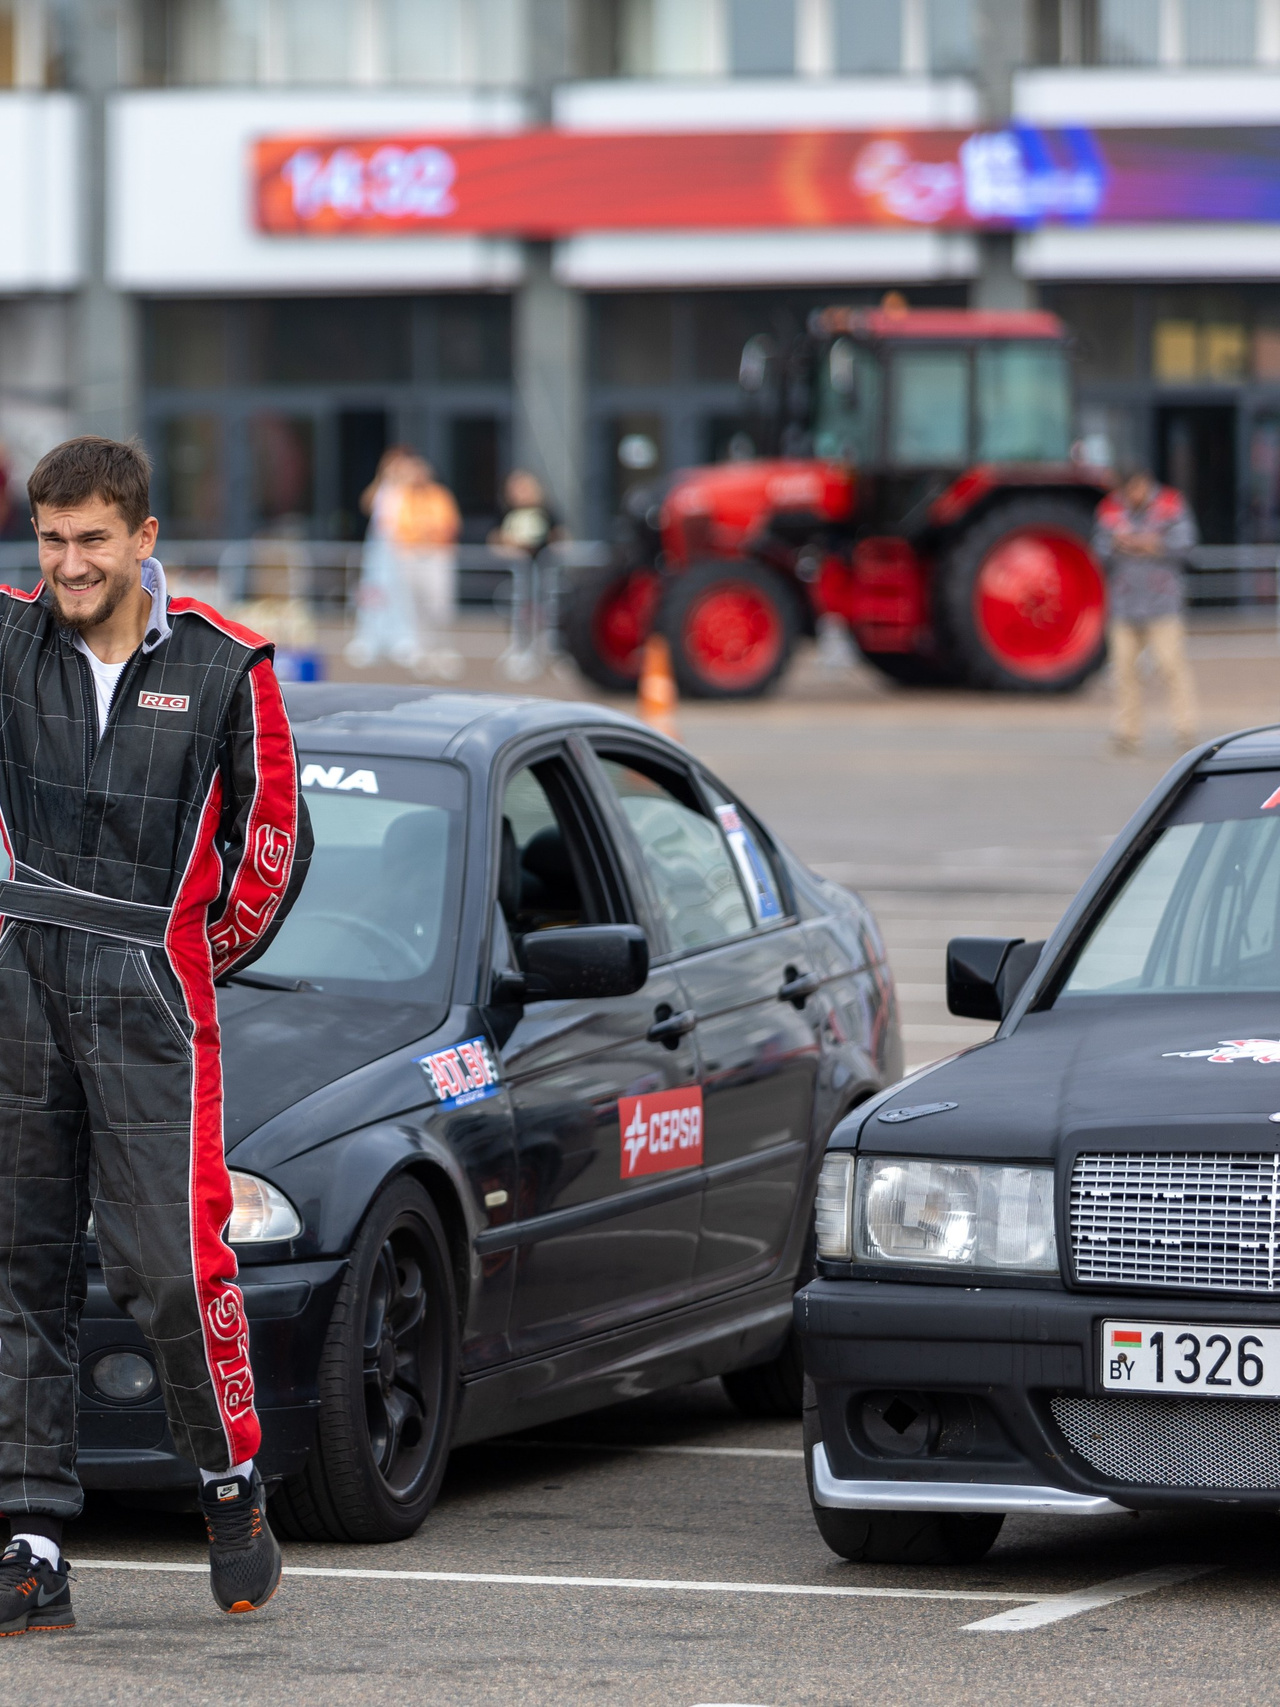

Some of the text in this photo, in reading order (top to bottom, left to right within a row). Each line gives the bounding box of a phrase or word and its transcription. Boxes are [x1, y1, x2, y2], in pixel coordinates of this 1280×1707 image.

[143, 695, 184, 708] RLG
[209, 823, 291, 970] RLG
[427, 1040, 493, 1100] ADT.BY
[649, 1106, 700, 1153] CEPSA
[207, 1289, 254, 1422] RLG
[1110, 1360, 1135, 1380] BY
[1150, 1331, 1264, 1387] 1326
